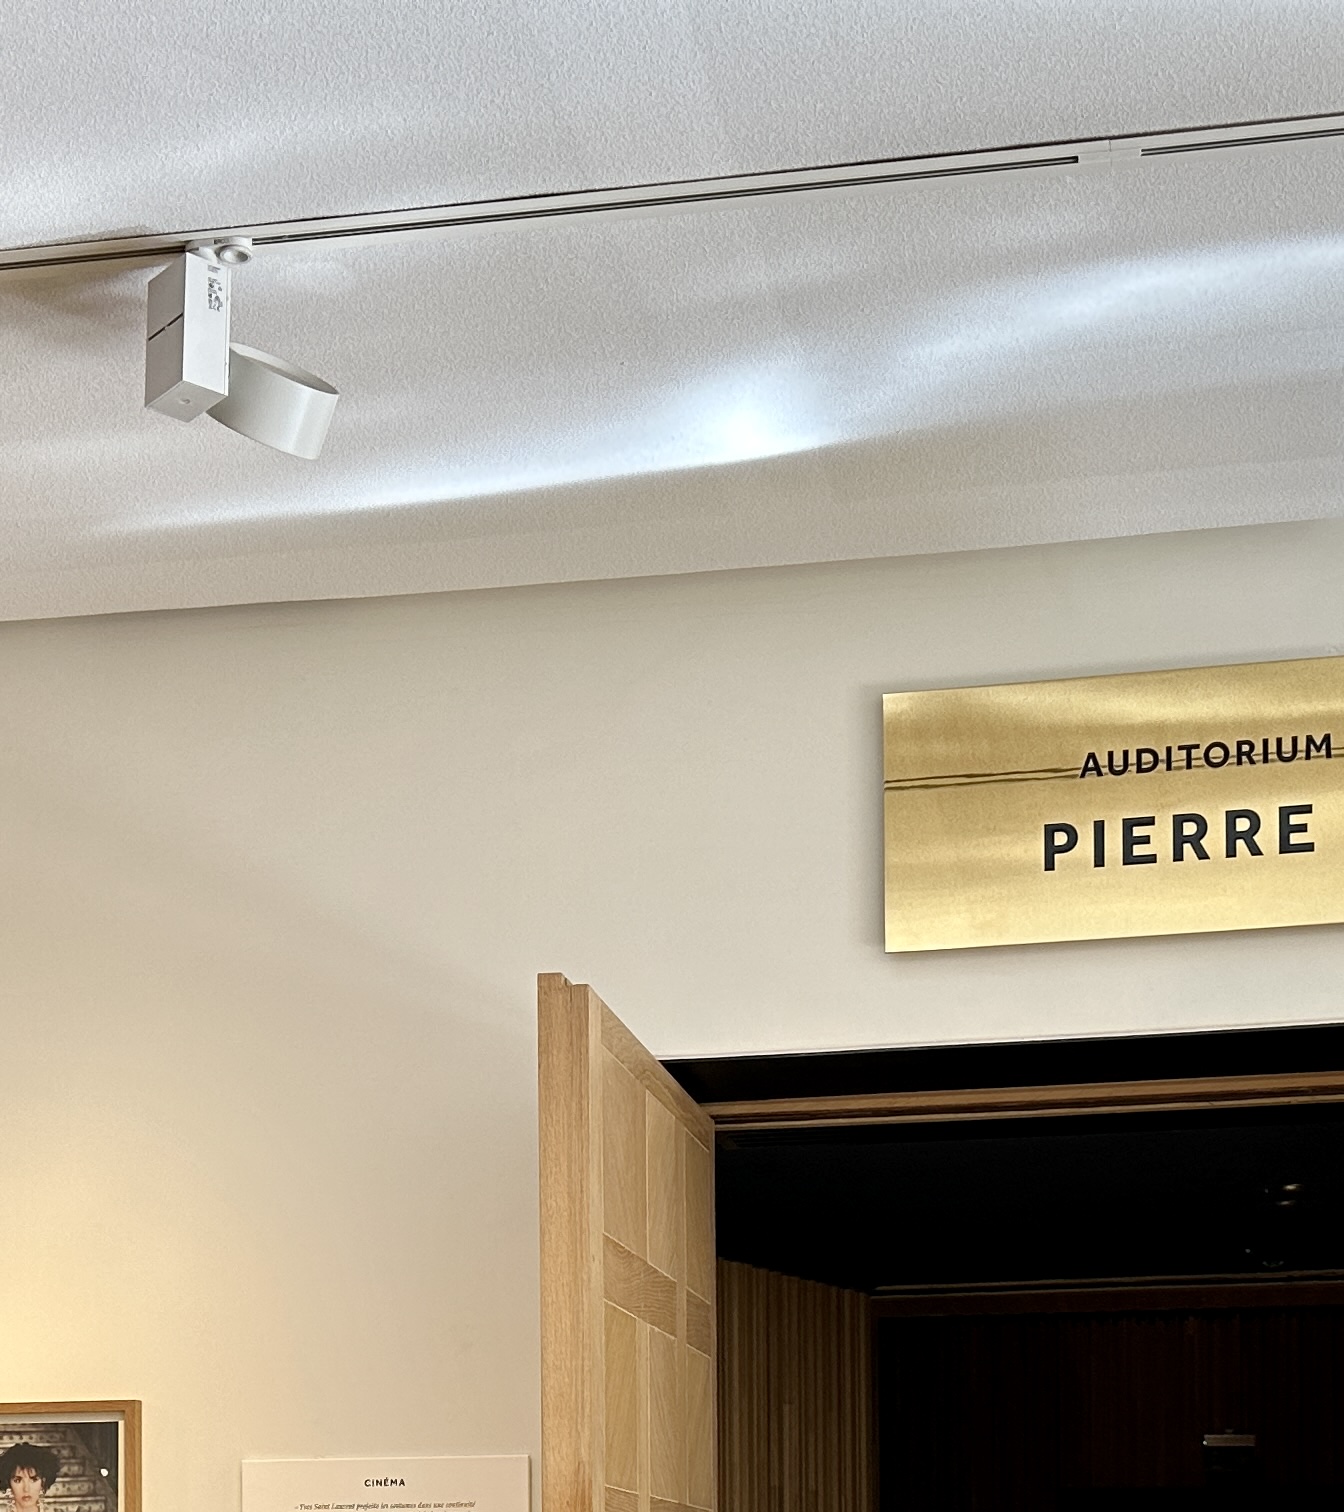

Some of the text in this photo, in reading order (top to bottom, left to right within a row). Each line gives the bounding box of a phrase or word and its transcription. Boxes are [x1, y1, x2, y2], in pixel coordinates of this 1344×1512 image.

[1079, 731, 1333, 779] AUDITORIUM
[1042, 805, 1316, 872] PIERRE
[364, 1477, 406, 1488] CINÉMA
